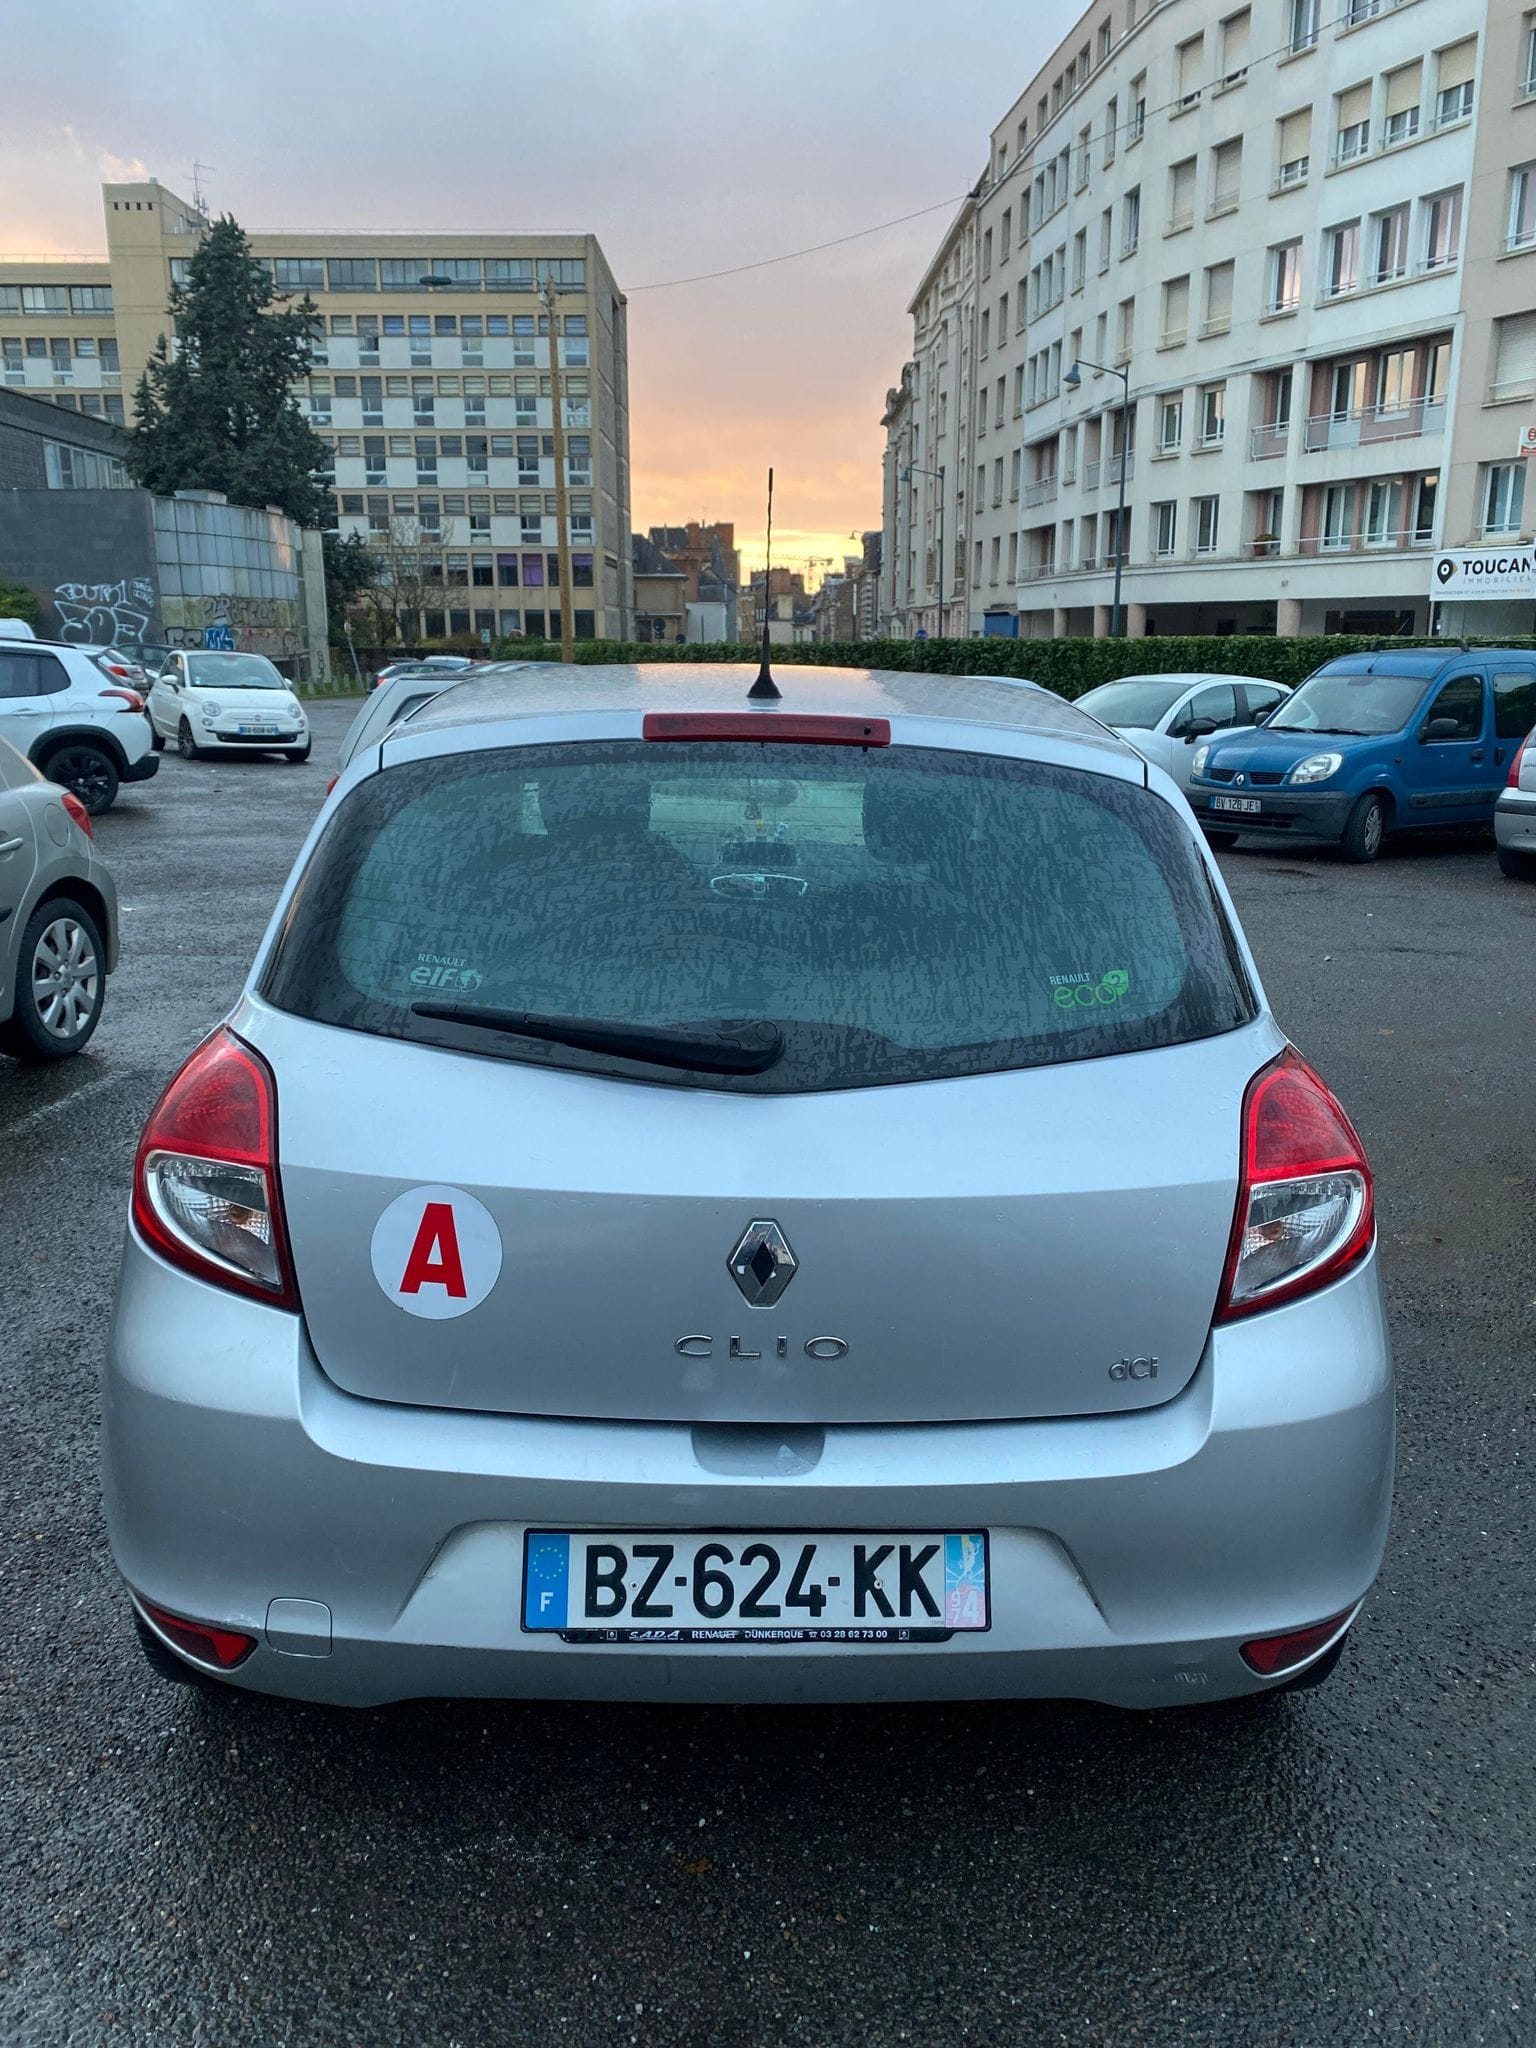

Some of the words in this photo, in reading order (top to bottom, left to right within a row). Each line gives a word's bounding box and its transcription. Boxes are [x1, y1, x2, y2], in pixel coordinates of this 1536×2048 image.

[1463, 558, 1531, 575] TOUCAN
[417, 953, 467, 967] RENAULT
[409, 966, 458, 987] elf
[1049, 972, 1090, 985] RENAULT
[399, 1202, 467, 1298] A
[674, 1334, 850, 1360] CLIO
[1108, 1357, 1159, 1381] dCi
[585, 1543, 941, 1618] BZ-624-KK
[540, 1591, 554, 1612] F
[820, 1630, 832, 1639] 03
[834, 1630, 846, 1639] 28
[862, 1630, 874, 1639] 73
[875, 1630, 888, 1639] 00
